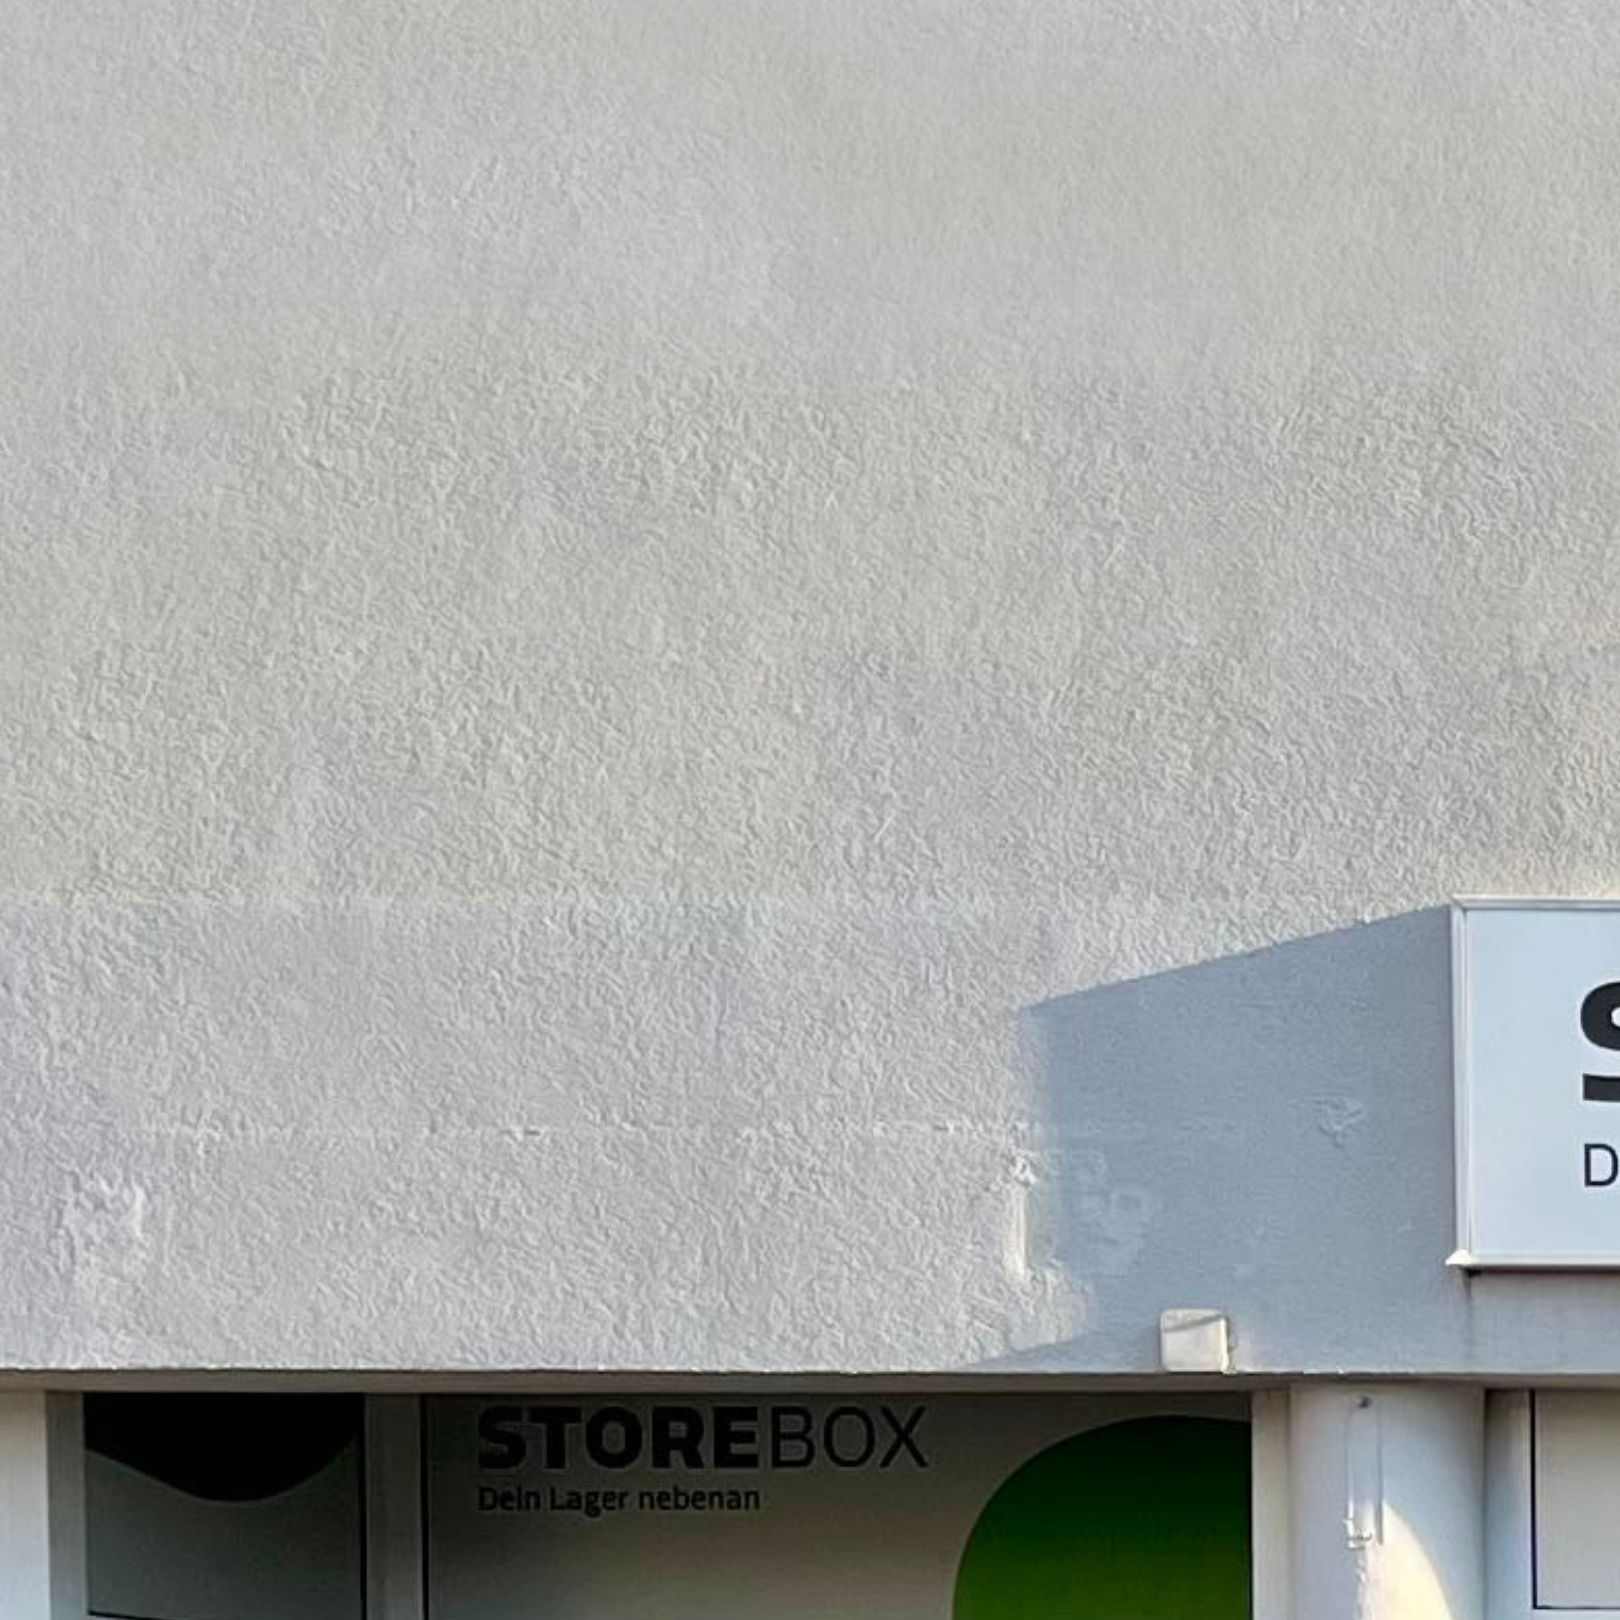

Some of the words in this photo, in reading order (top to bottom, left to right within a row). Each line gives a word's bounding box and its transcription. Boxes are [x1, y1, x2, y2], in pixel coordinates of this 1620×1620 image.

[478, 1406, 929, 1468] STOREBOX
[479, 1486, 541, 1510] Dein
[551, 1487, 629, 1517] Lager
[639, 1486, 760, 1510] nebenan
